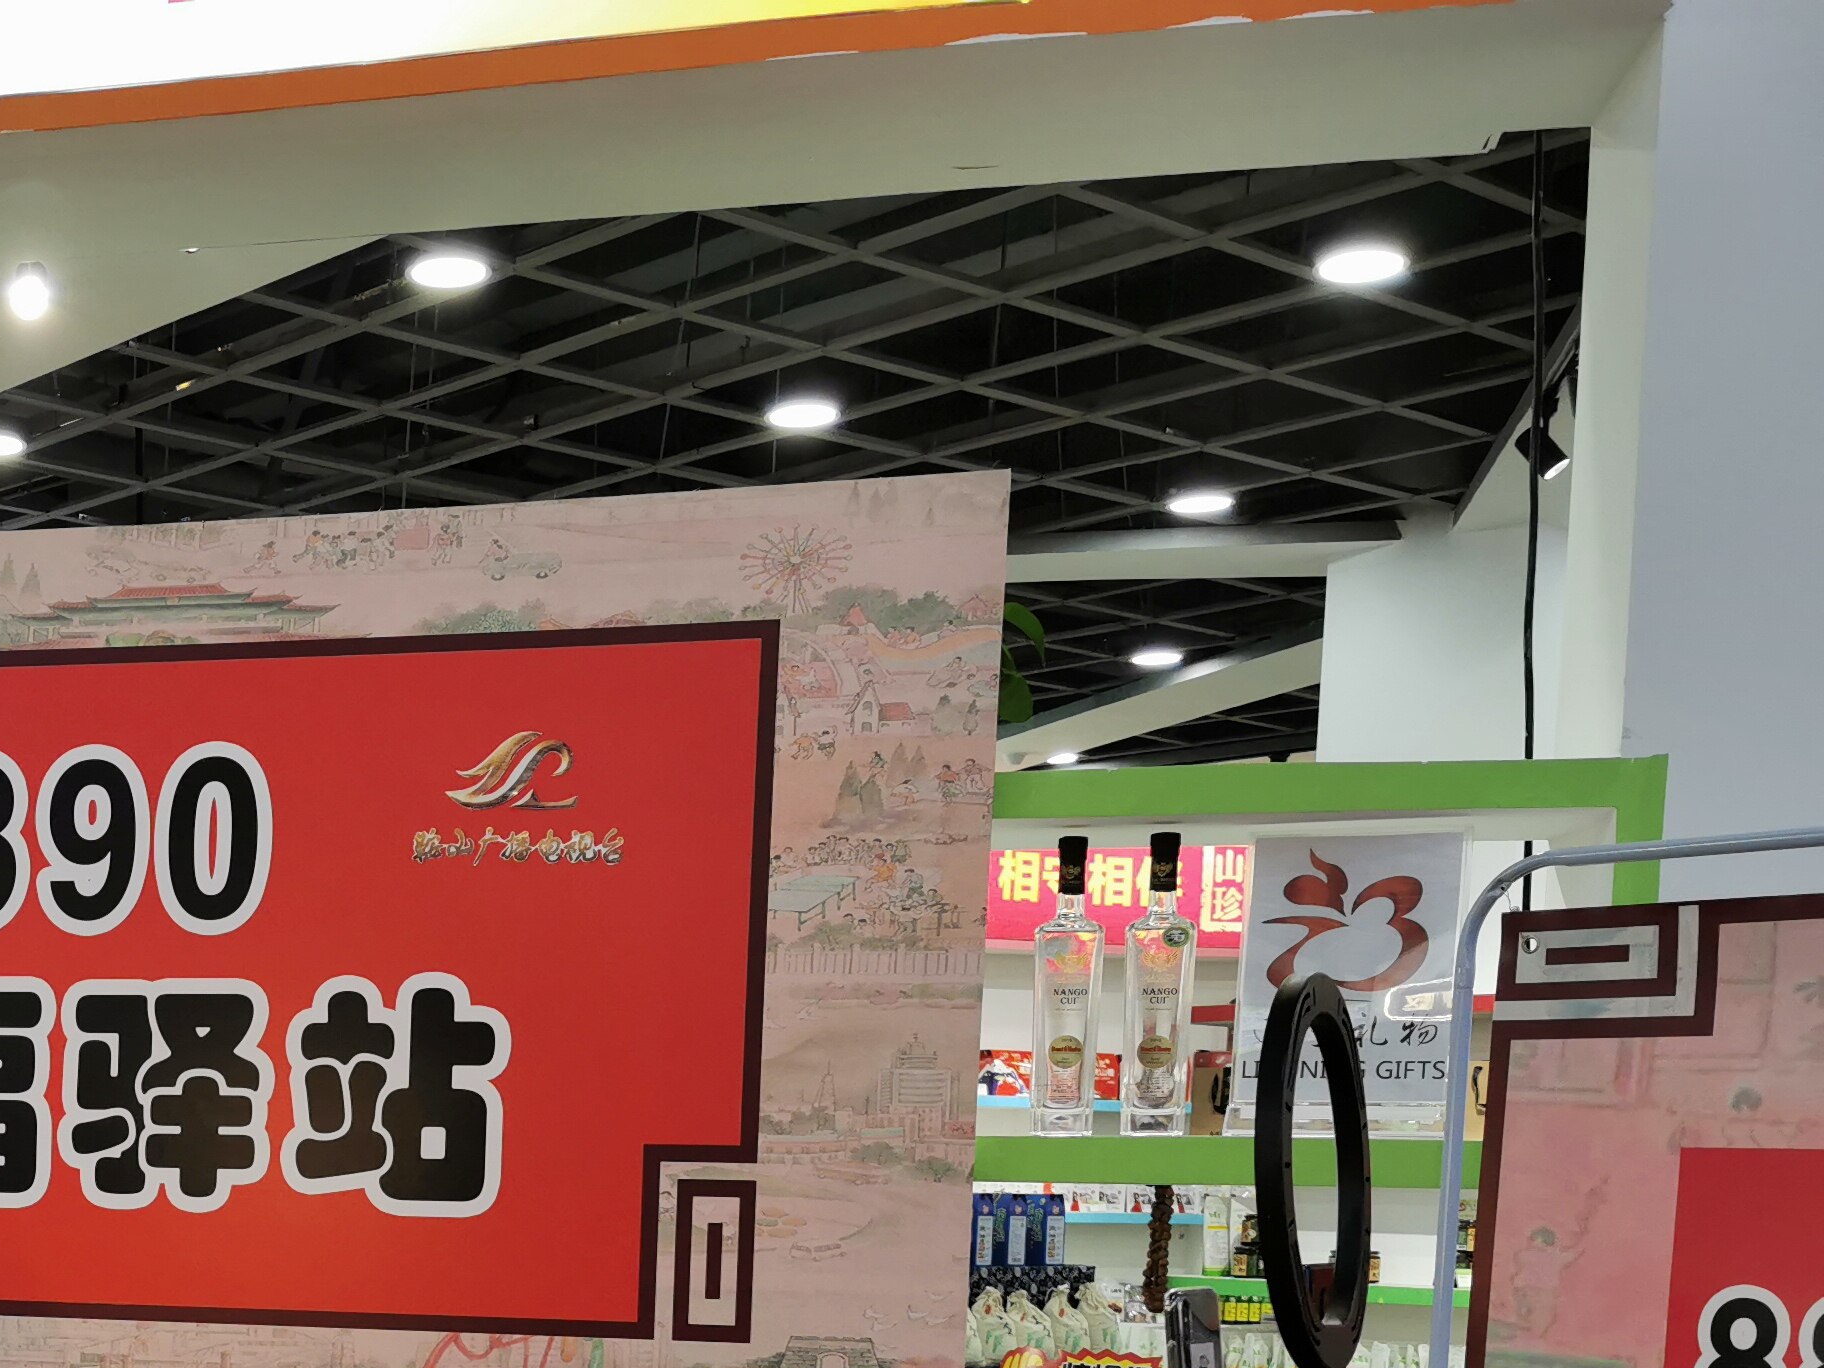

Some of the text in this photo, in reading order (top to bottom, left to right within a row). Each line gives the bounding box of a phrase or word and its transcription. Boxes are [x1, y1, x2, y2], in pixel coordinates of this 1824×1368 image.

[411, 826, 625, 867] 鞍山广播电视台
[1053, 988, 1088, 996] NANGO
[1141, 987, 1178, 996] NANGO
[1377, 1060, 1445, 1080] GIFTS
